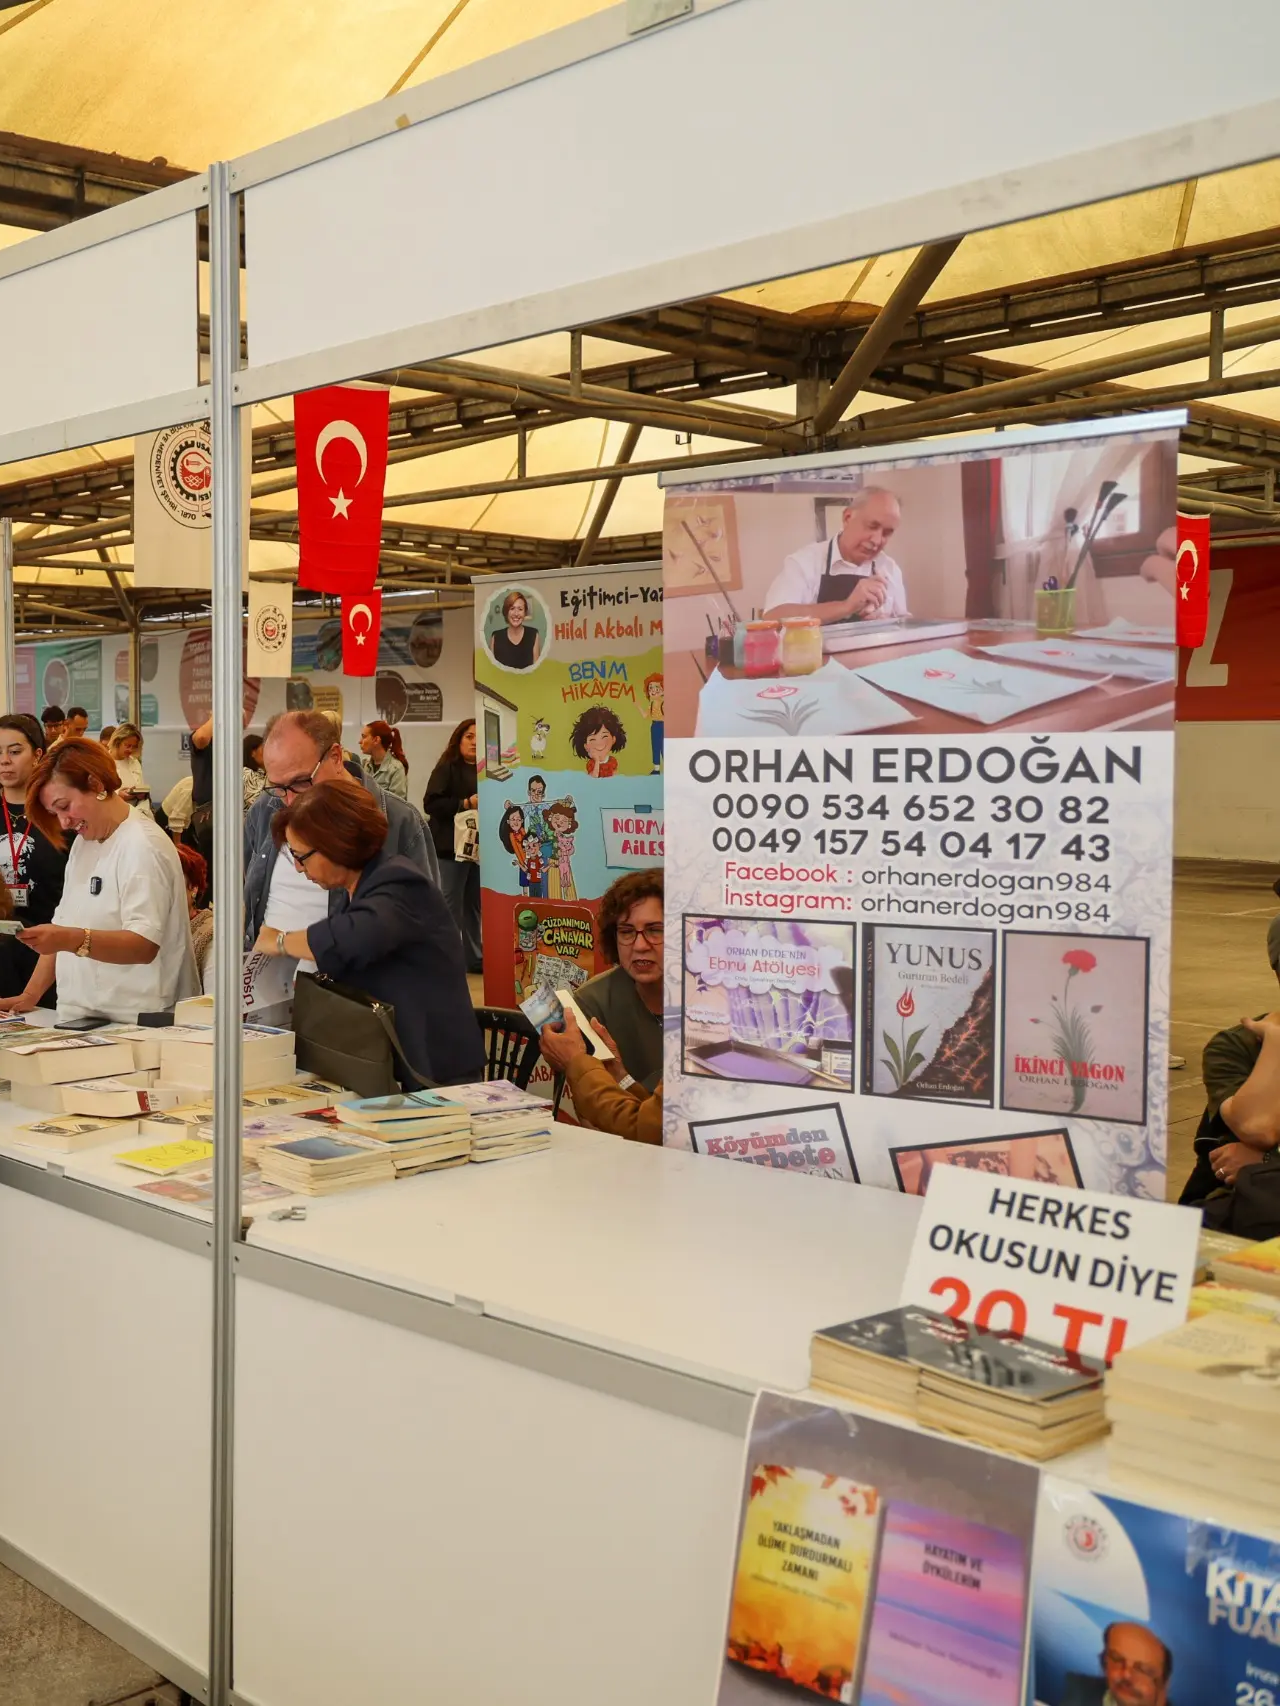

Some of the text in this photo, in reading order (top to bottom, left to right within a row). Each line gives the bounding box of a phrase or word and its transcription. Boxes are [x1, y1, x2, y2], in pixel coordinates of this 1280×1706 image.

[154, 443, 165, 489] MEDENİYET
[180, 510, 197, 521] 1870
[554, 618, 588, 640] Hilal
[594, 615, 643, 639] Akbalı
[569, 660, 628, 681] BENİM
[688, 735, 1142, 785] ORHAN ERDOĞAN
[712, 793, 1109, 824] 0090 534 652 30 82
[712, 827, 1110, 862] 0049 157 54 04 17 43
[725, 861, 838, 884] Facebook
[861, 865, 1111, 896] orhanerdogan984
[725, 884, 1111, 924] İnstagram: orhanerdogan984
[542, 917, 591, 932] CÜZDANIMDA
[543, 928, 594, 950] CANAVAR
[556, 944, 580, 958] VAR!
[726, 946, 758, 957] ORHAN
[885, 942, 983, 971] YUNUS
[709, 956, 822, 978] Ebru Atölyesi
[940, 972, 970, 986] Bedeli
[1014, 1053, 1126, 1084] İKİNCİ VAGON
[1018, 1073, 1060, 1086] ORHAN
[705, 1128, 829, 1156] Köyümden
[715, 1145, 836, 1170] rbete
[988, 1188, 1132, 1241] HERKES
[928, 1223, 1179, 1304] OKUSUN DİYE
[928, 1276, 1027, 1335] 20
[772, 1519, 841, 1550] YAKLAŞMADAN
[757, 1532, 853, 1574] ÖLÜME DURDURMALI
[924, 1543, 984, 1573] HAYATIM VE
[781, 1558, 819, 1582] ZAMANI
[922, 1561, 982, 1592] ÖYKÜLERİM
